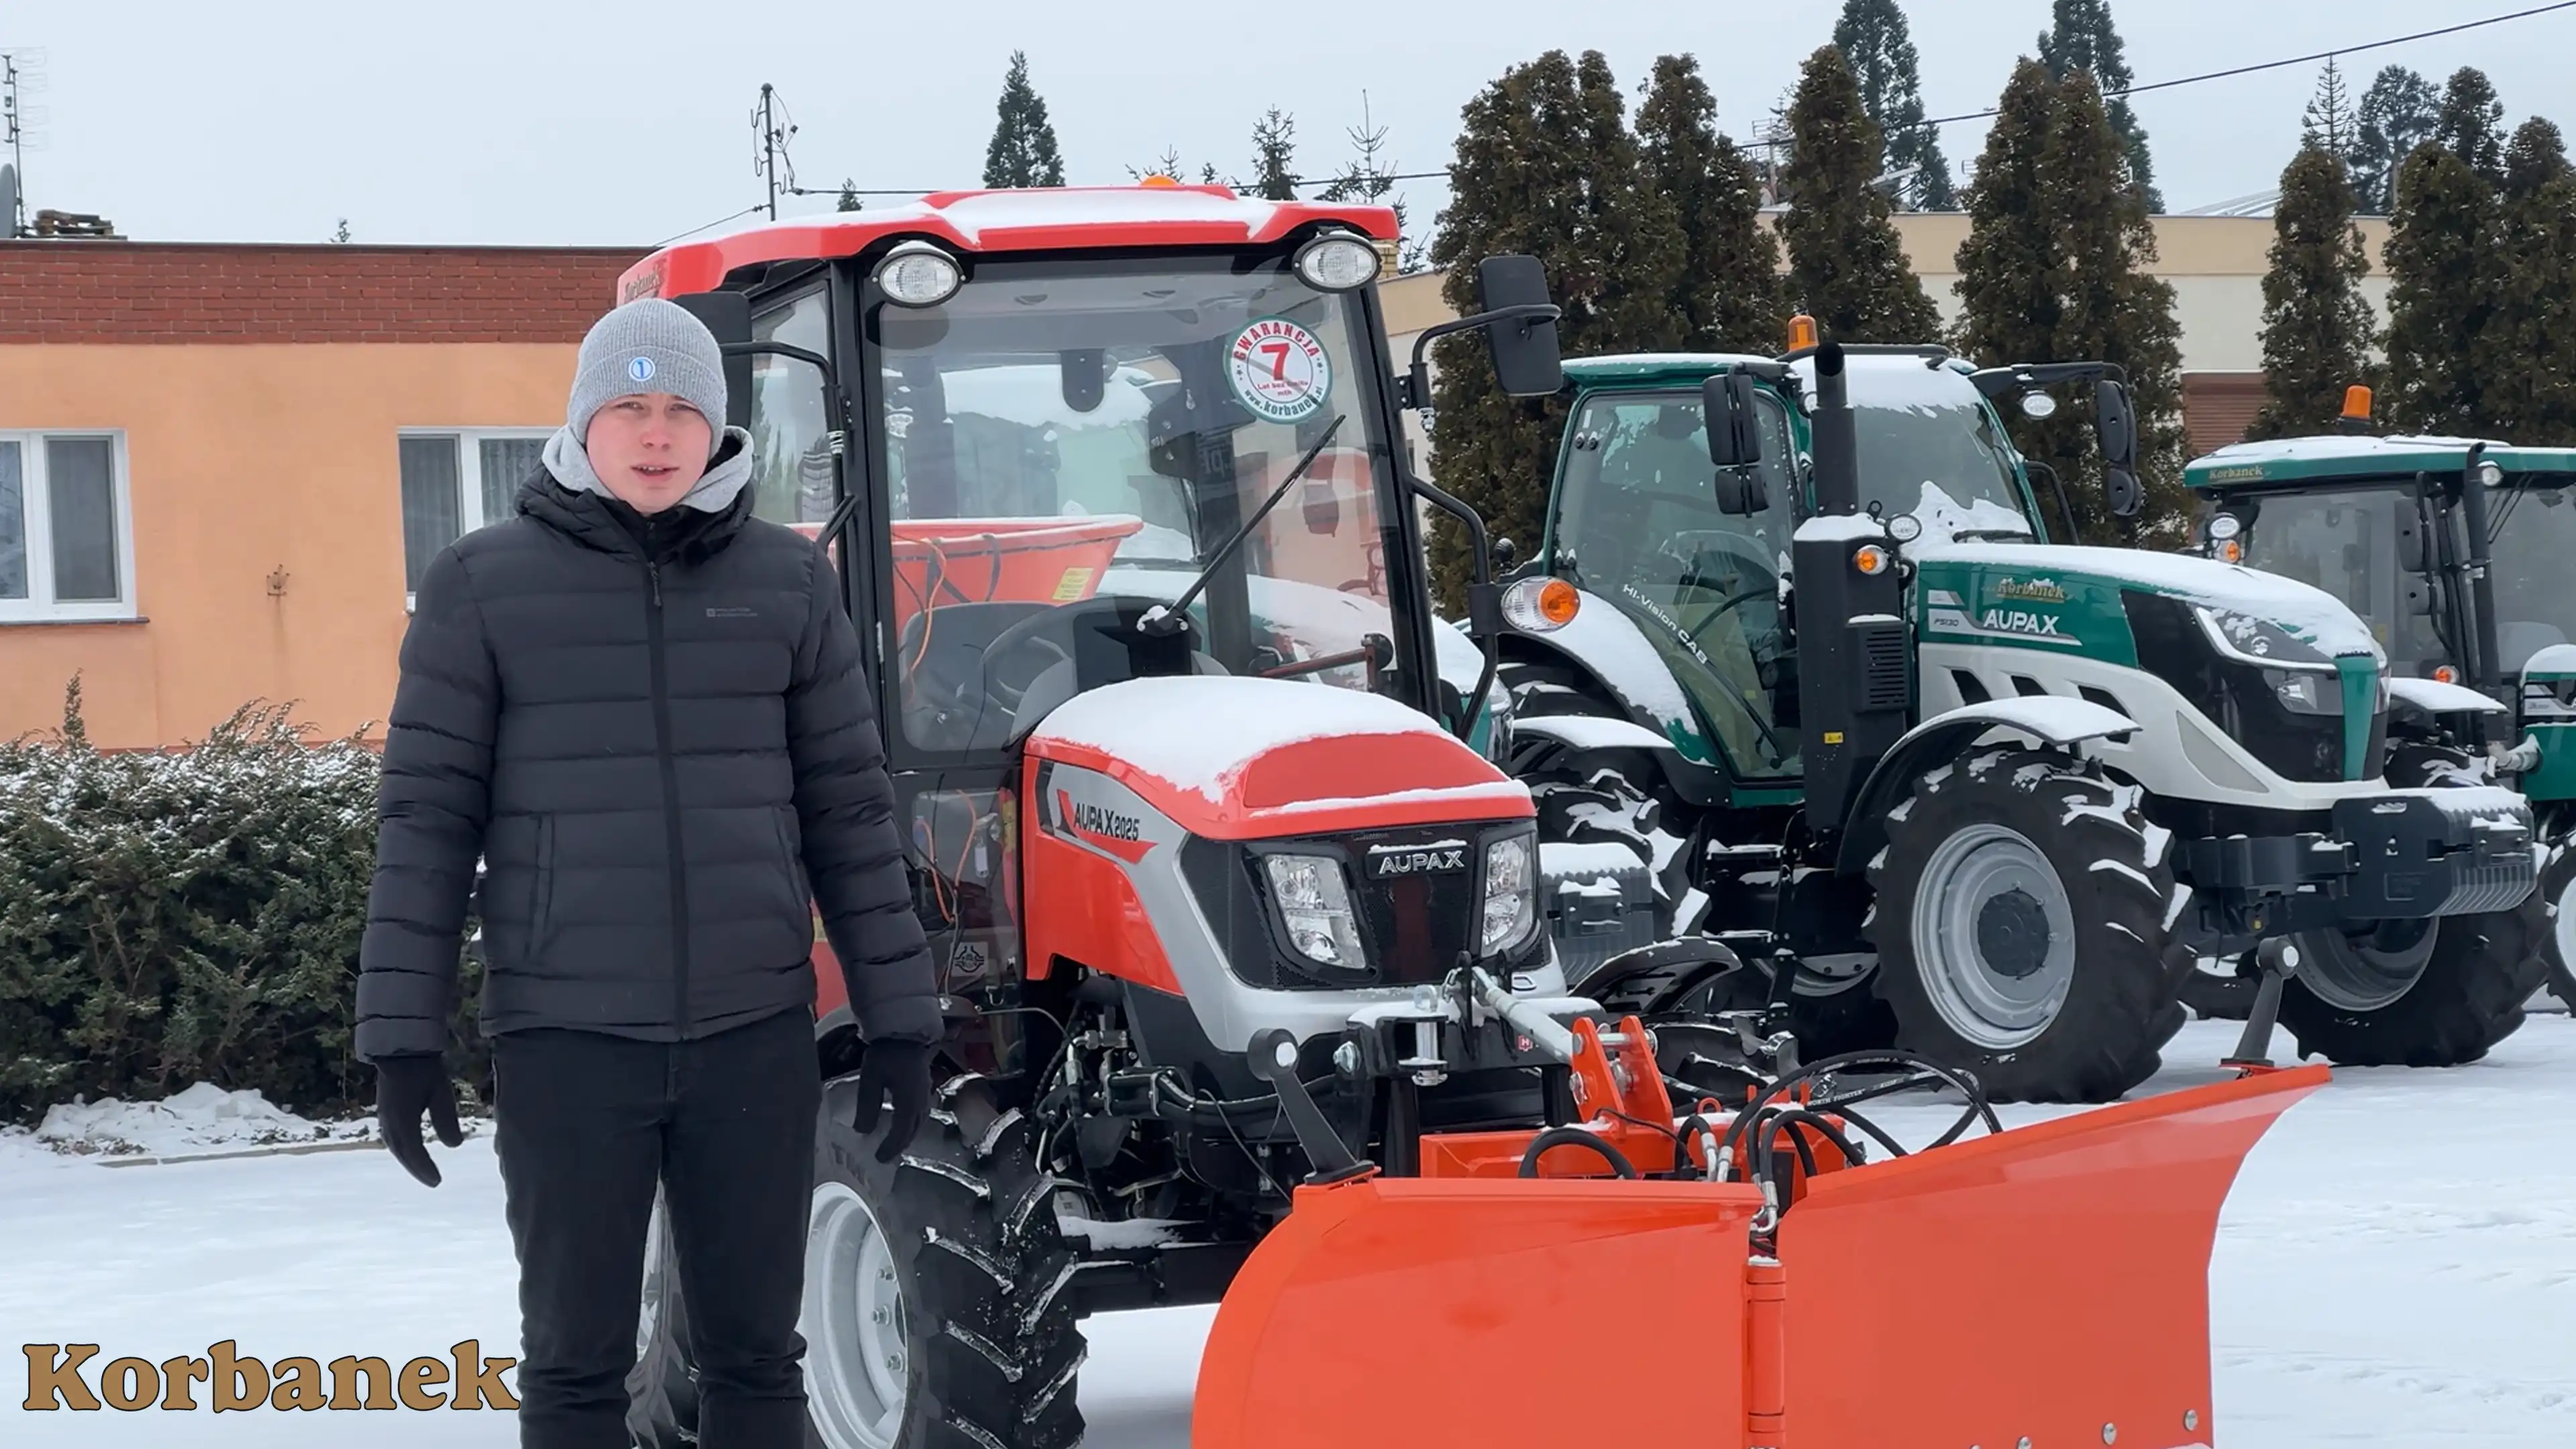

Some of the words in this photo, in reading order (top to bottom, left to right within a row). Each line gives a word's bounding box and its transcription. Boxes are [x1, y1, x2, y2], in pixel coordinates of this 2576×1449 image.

[1233, 322, 1320, 362] GWARANCJA
[1260, 343, 1291, 381] 7
[2208, 464, 2264, 480] Korbanek
[1983, 609, 2059, 635] AUPAX
[1678, 629, 1708, 664] CAB
[1379, 850, 1465, 874] AUPAX
